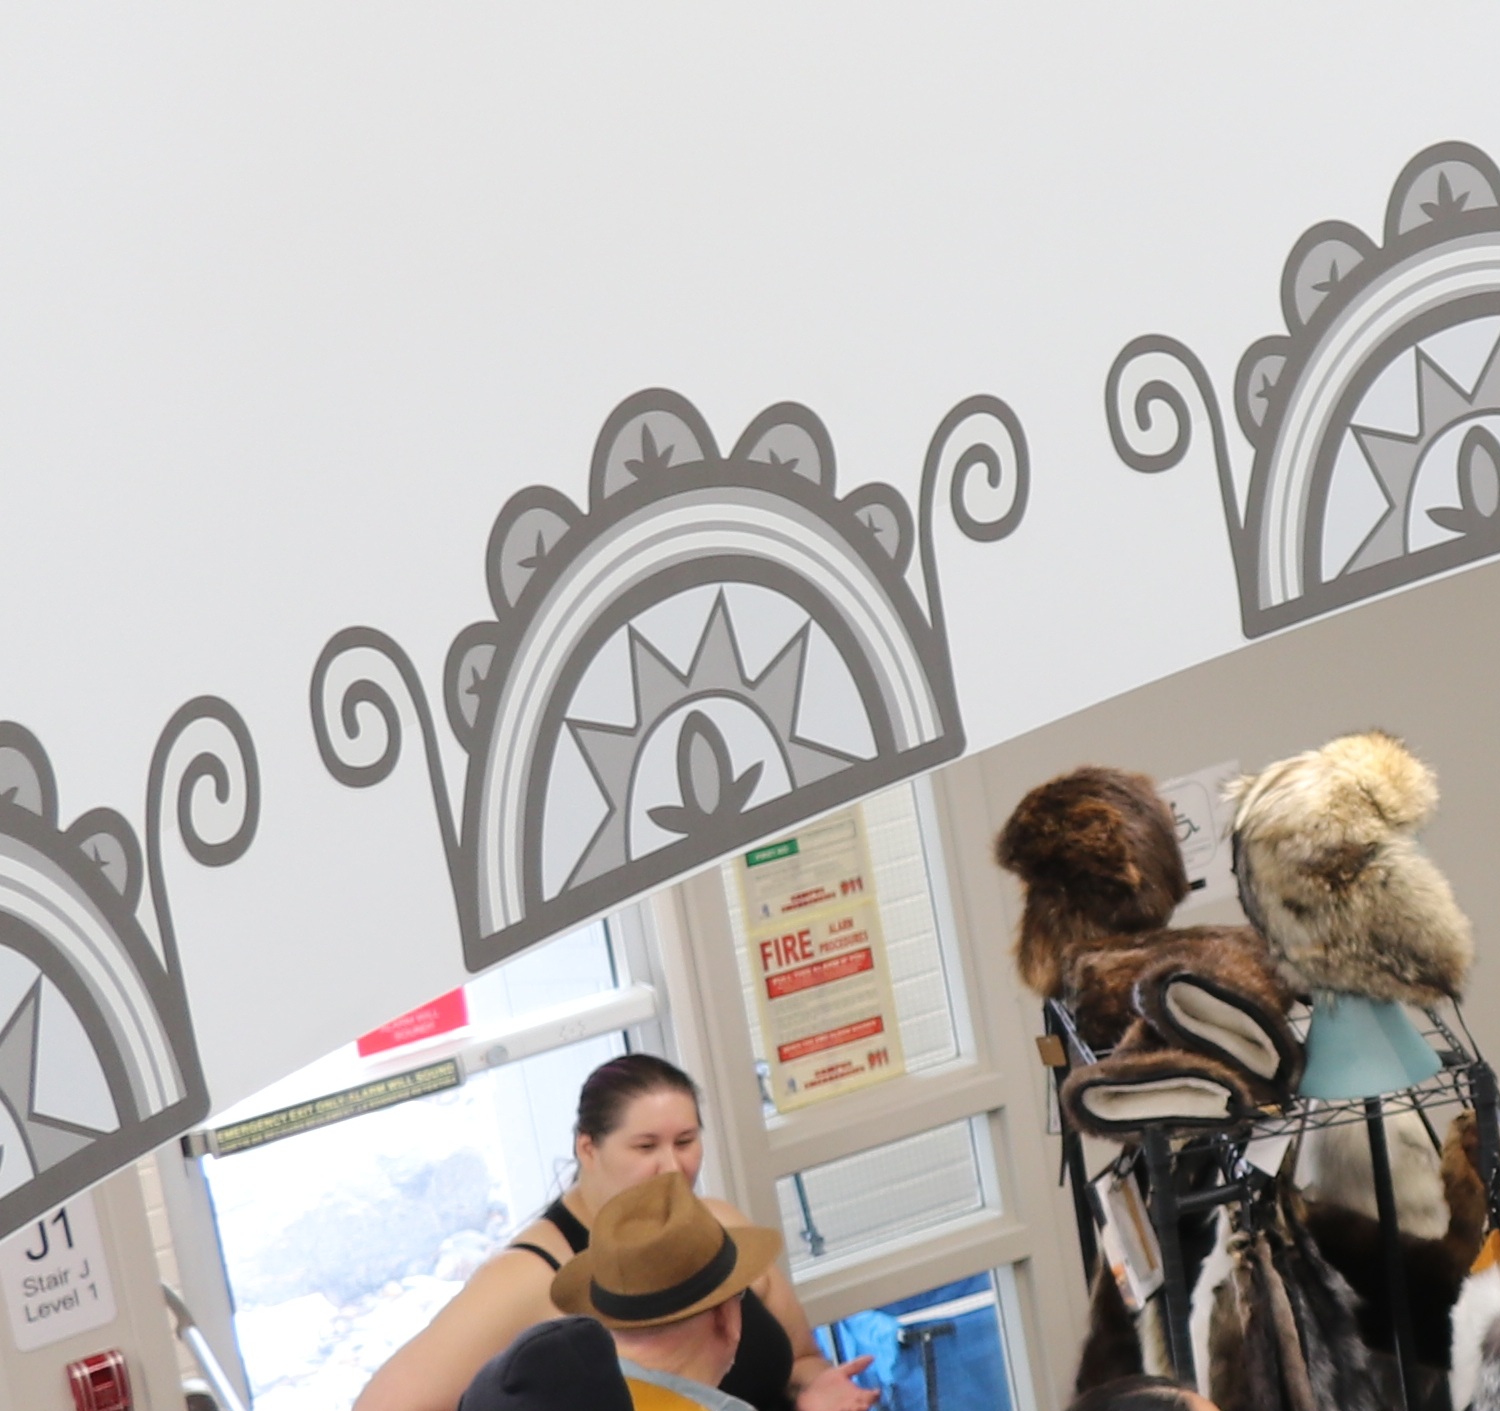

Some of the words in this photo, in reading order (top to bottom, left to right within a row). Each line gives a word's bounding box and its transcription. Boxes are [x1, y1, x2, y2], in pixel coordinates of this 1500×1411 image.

[840, 875, 864, 896] 911
[819, 930, 868, 955] PROCEDURES
[828, 916, 854, 934] ALARM
[759, 929, 814, 972] FIRE
[867, 1047, 889, 1070] 911
[217, 1115, 287, 1143] EMERGENCY
[289, 1105, 314, 1124] EXIT
[26, 1206, 73, 1261] J1
[23, 1267, 69, 1298] Stair
[80, 1258, 91, 1279] J
[25, 1288, 80, 1323] Level
[89, 1282, 98, 1300] 1
